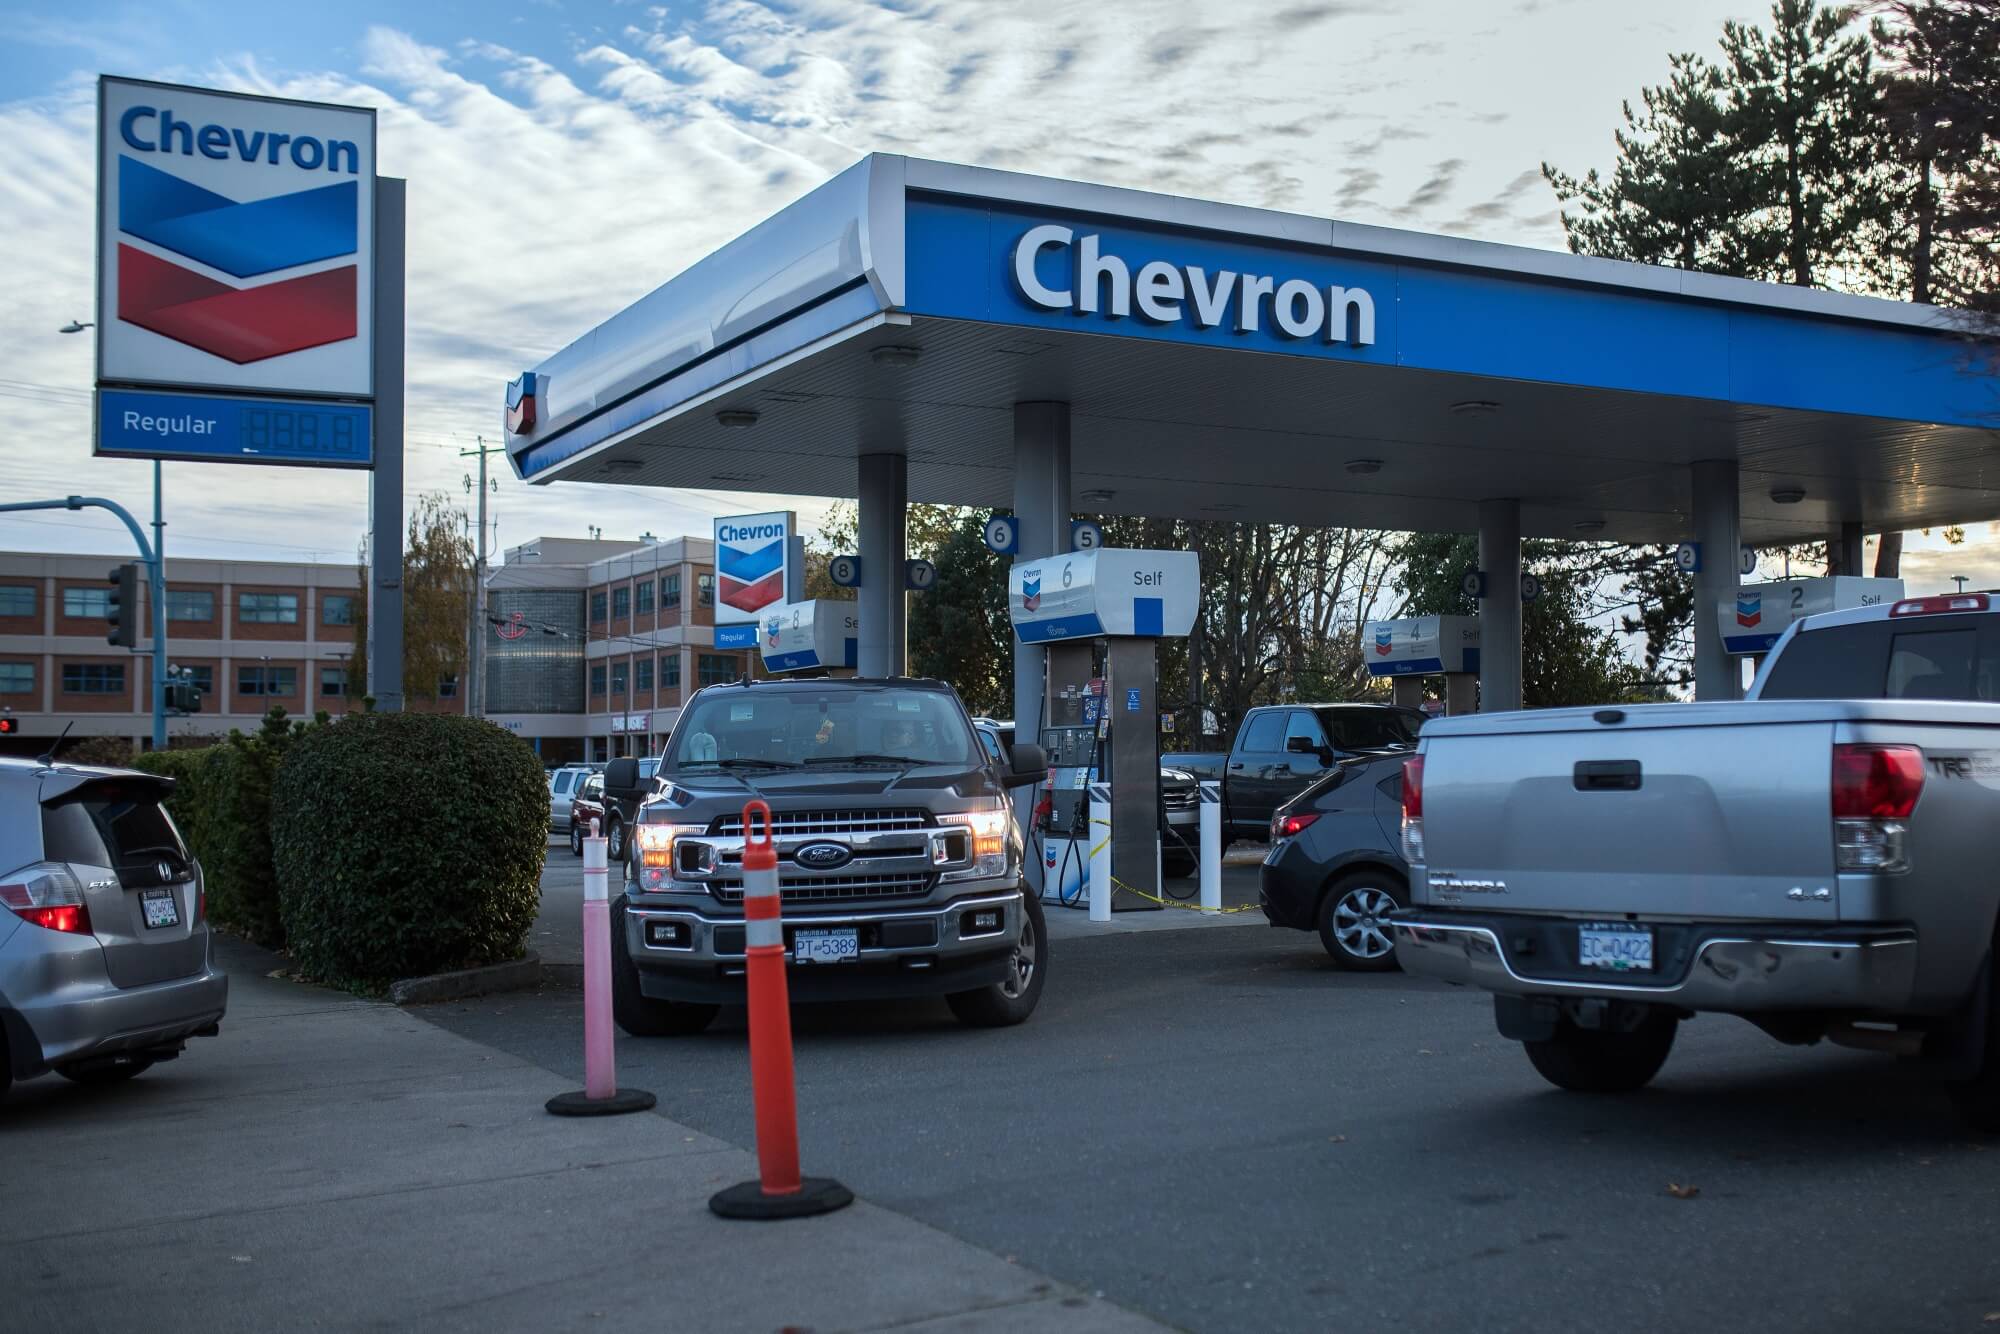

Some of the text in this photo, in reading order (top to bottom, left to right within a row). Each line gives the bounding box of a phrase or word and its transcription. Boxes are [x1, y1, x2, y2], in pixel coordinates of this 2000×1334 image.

[119, 105, 359, 175] Chevron
[1011, 224, 1376, 346] Chevron
[123, 411, 217, 437] Regular
[718, 523, 784, 543] Chevron
[994, 526, 1005, 544] 6
[1081, 531, 1092, 548] 5
[1682, 550, 1691, 564] 2
[838, 563, 849, 578] 8
[918, 567, 926, 579] 7
[1062, 561, 1073, 588] 6
[1133, 570, 1163, 586] Self
[1468, 578, 1476, 591] 4
[1525, 581, 1534, 593] 3
[1790, 586, 1804, 609] 2
[1861, 594, 1881, 607] Self
[792, 609, 800, 631] 8
[844, 617, 858, 629] Se
[1410, 622, 1421, 641] 4
[810, 849, 837, 860] Ford
[1428, 878, 1511, 894] TUNDRA
[796, 937, 857, 957] PT 5389
[1583, 936, 1651, 961] EC 0422
